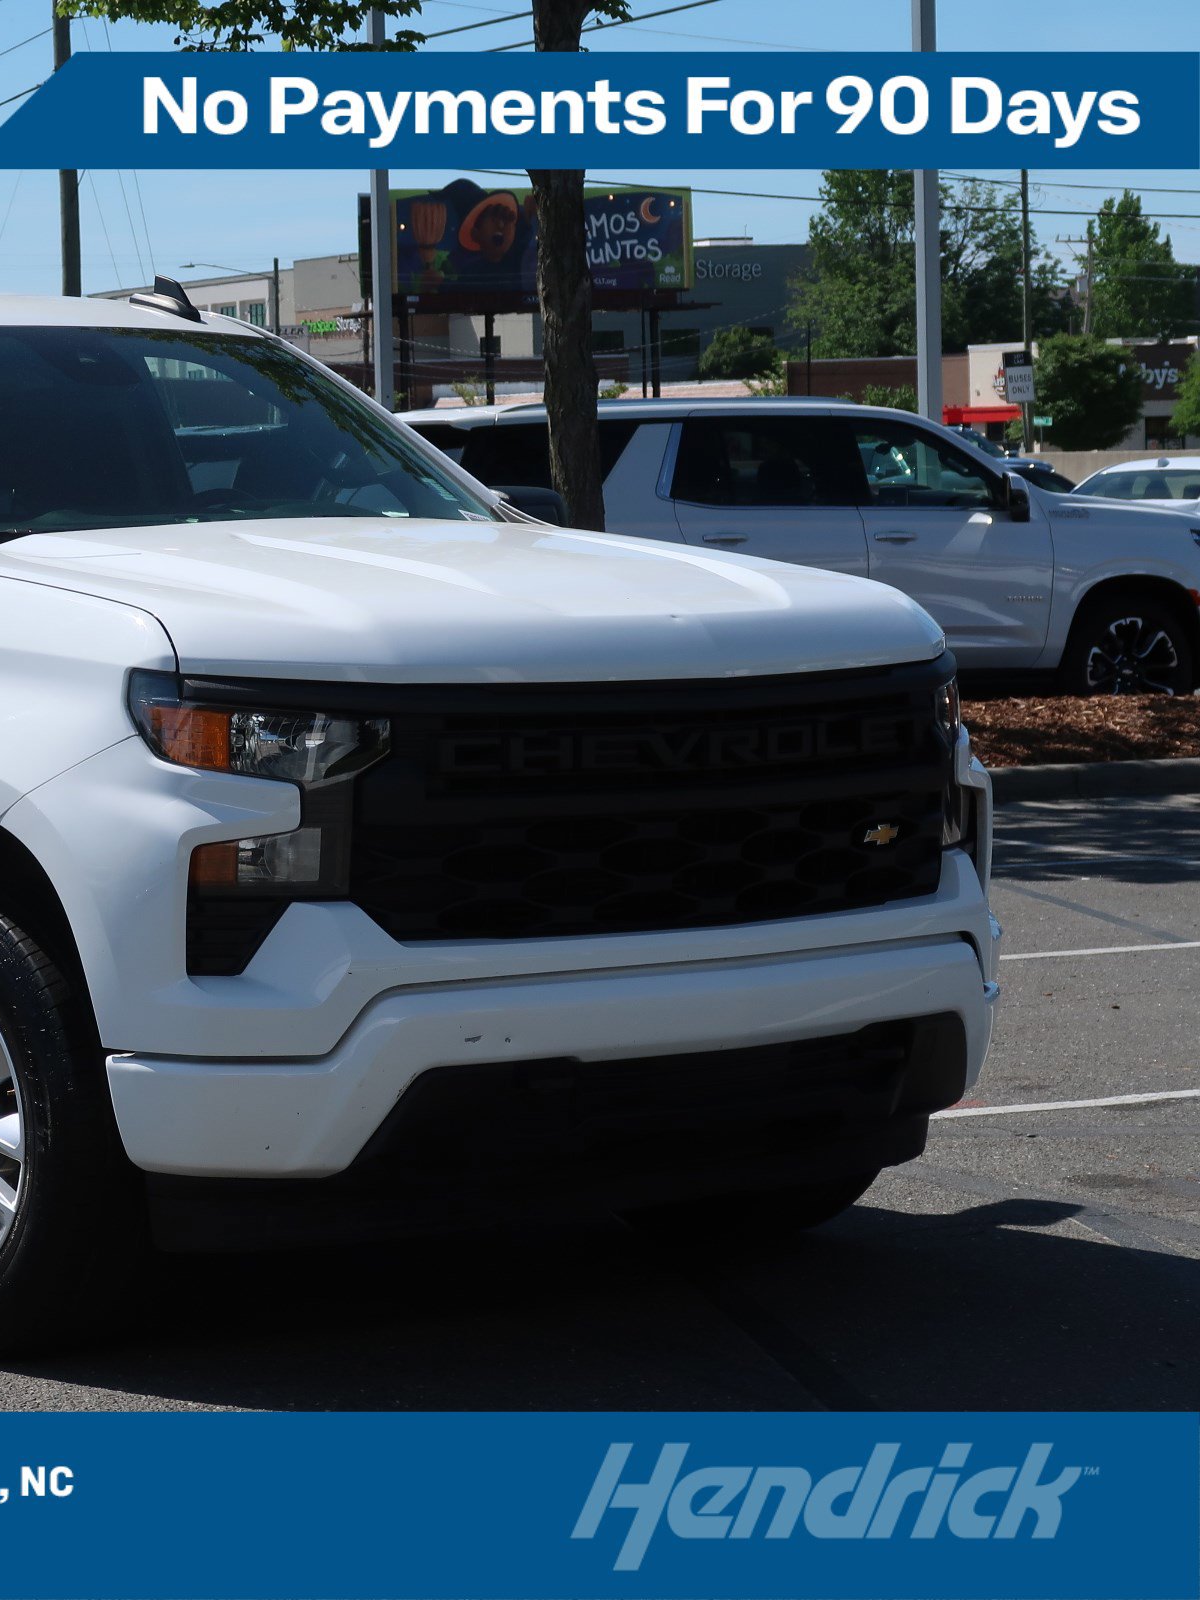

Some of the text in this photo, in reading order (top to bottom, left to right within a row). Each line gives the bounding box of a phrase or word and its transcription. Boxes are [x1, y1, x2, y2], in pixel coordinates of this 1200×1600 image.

[696, 259, 762, 281] Storage
[659, 272, 681, 283] Read
[1008, 373, 1032, 383] BUSES
[1012, 385, 1031, 394] ONLY
